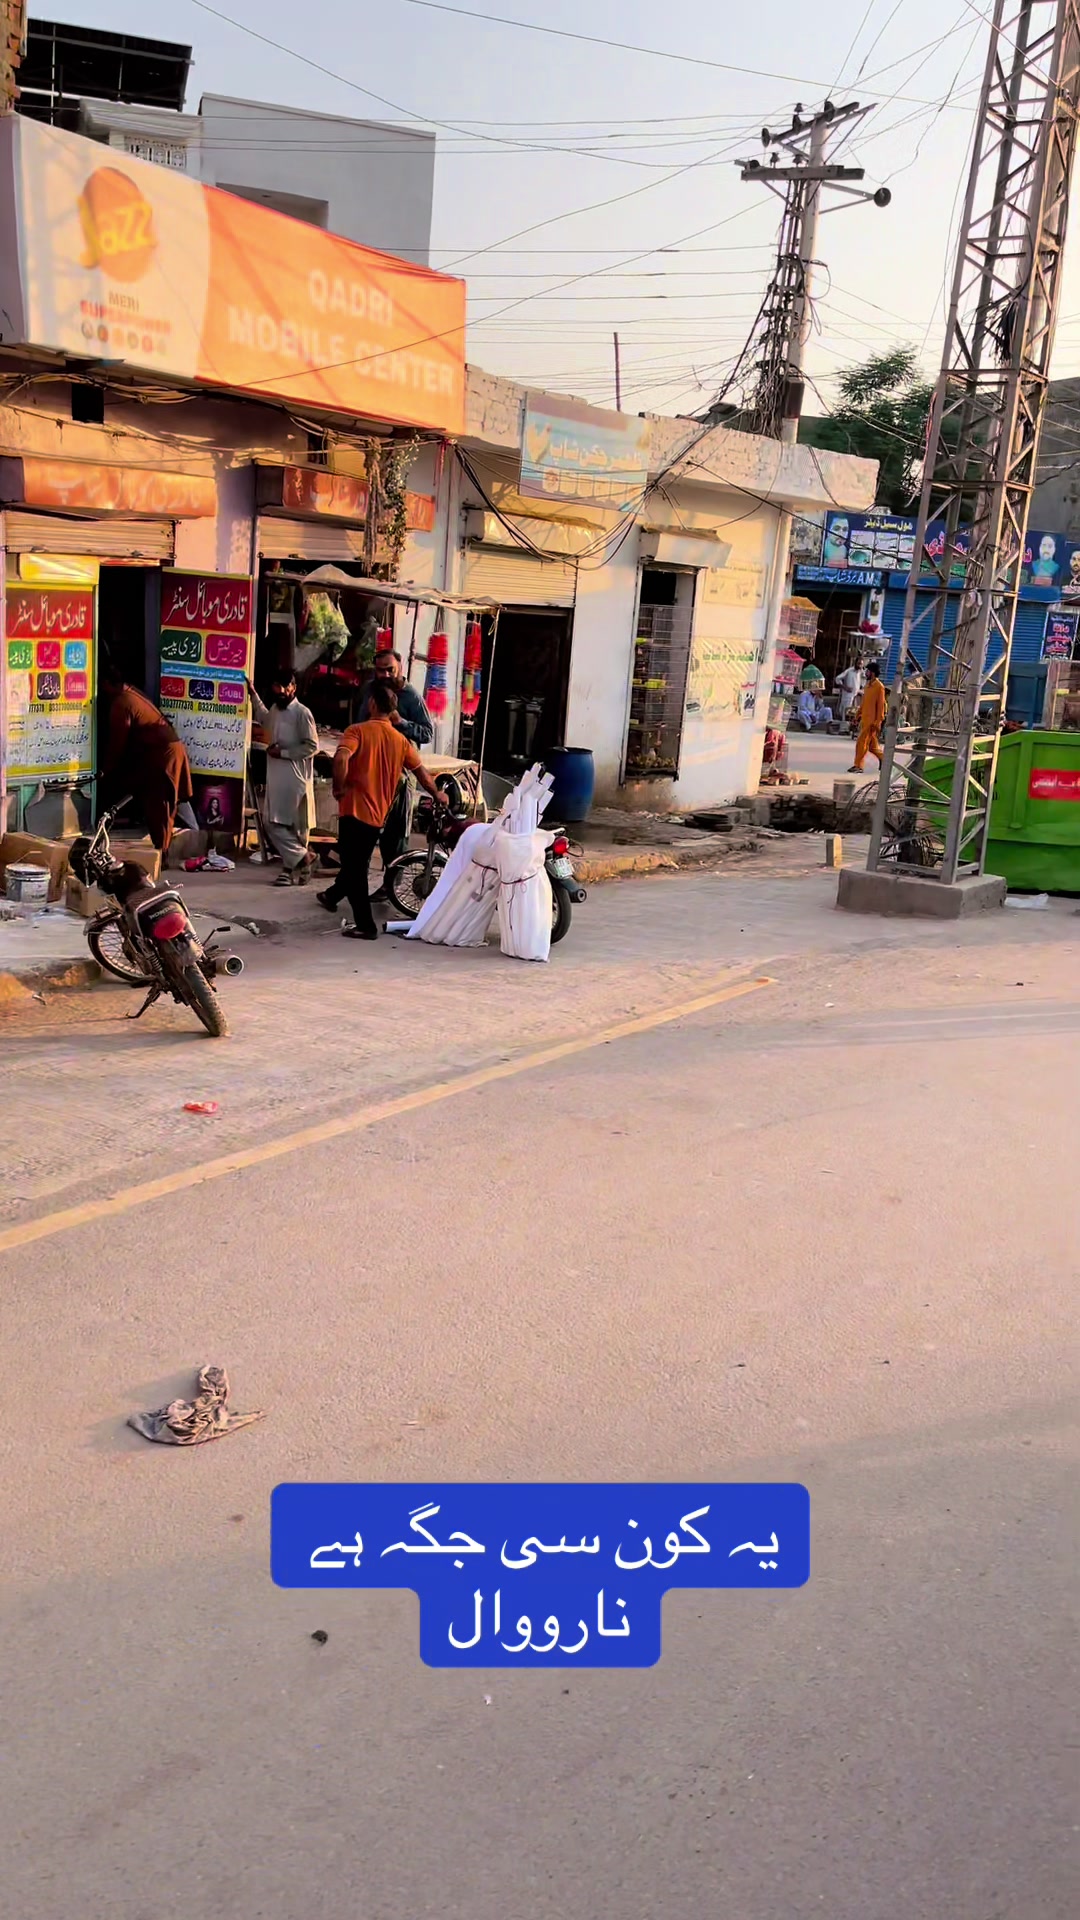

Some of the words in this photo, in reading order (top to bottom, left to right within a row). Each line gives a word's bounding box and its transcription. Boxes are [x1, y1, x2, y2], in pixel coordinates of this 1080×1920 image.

[108, 290, 141, 313] MERI
[308, 268, 394, 328] QADRI
[226, 304, 346, 367] MOBILE
[352, 340, 456, 395] CENTER
[30, 595, 62, 635] موبائل
[60, 602, 87, 632] قادری
[186, 580, 220, 625] موبائل
[217, 591, 248, 625] قادری
[227, 690, 244, 699] UBL
